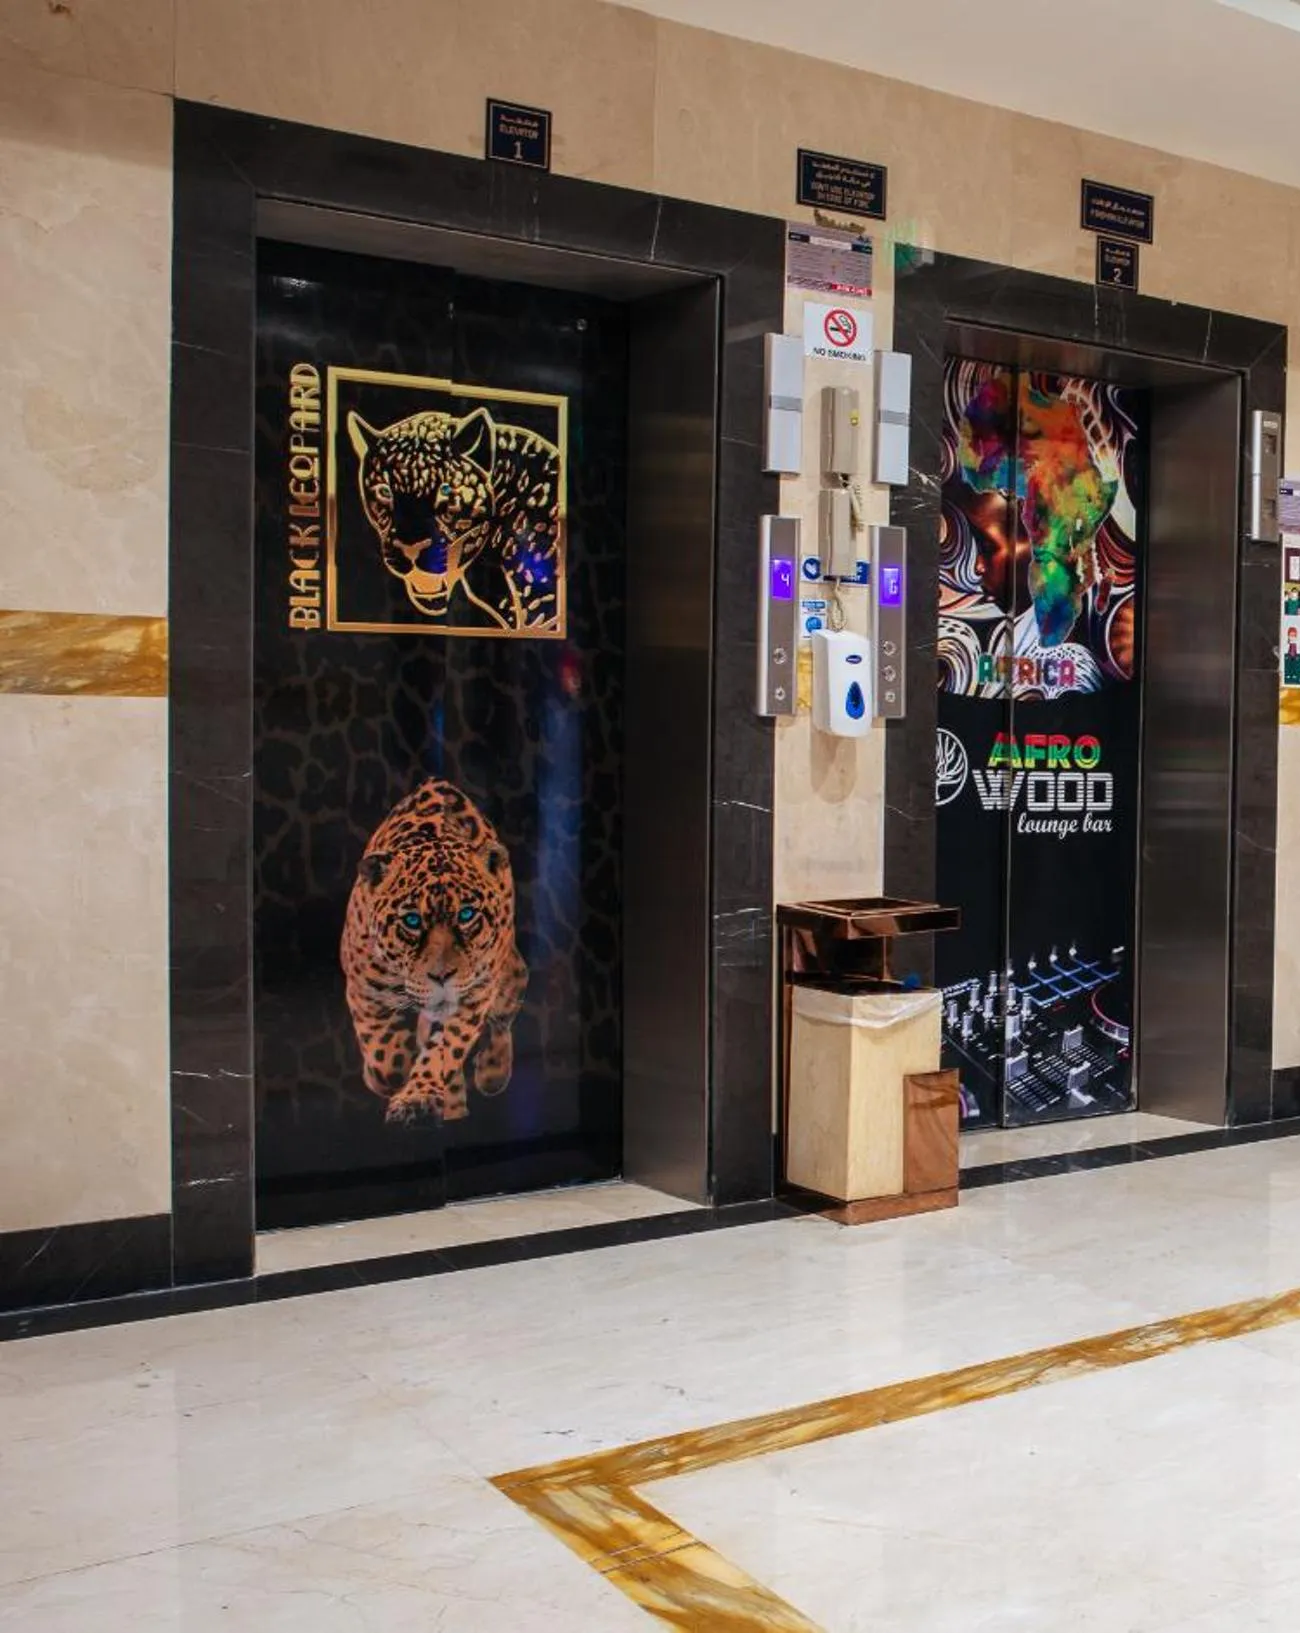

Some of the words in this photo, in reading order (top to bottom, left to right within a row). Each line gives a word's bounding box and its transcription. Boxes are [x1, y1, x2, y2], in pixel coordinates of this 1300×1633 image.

[513, 141, 523, 159] 1
[813, 347, 826, 356] NO
[828, 349, 866, 361] SMOKING
[289, 363, 321, 519] LEOPARD
[289, 522, 321, 630] BLACK
[978, 655, 1077, 687] AFRICA
[987, 732, 1101, 769] AFRO
[972, 770, 1114, 812] WOOD
[1017, 814, 1079, 839] lounge
[1082, 813, 1113, 833] bar
